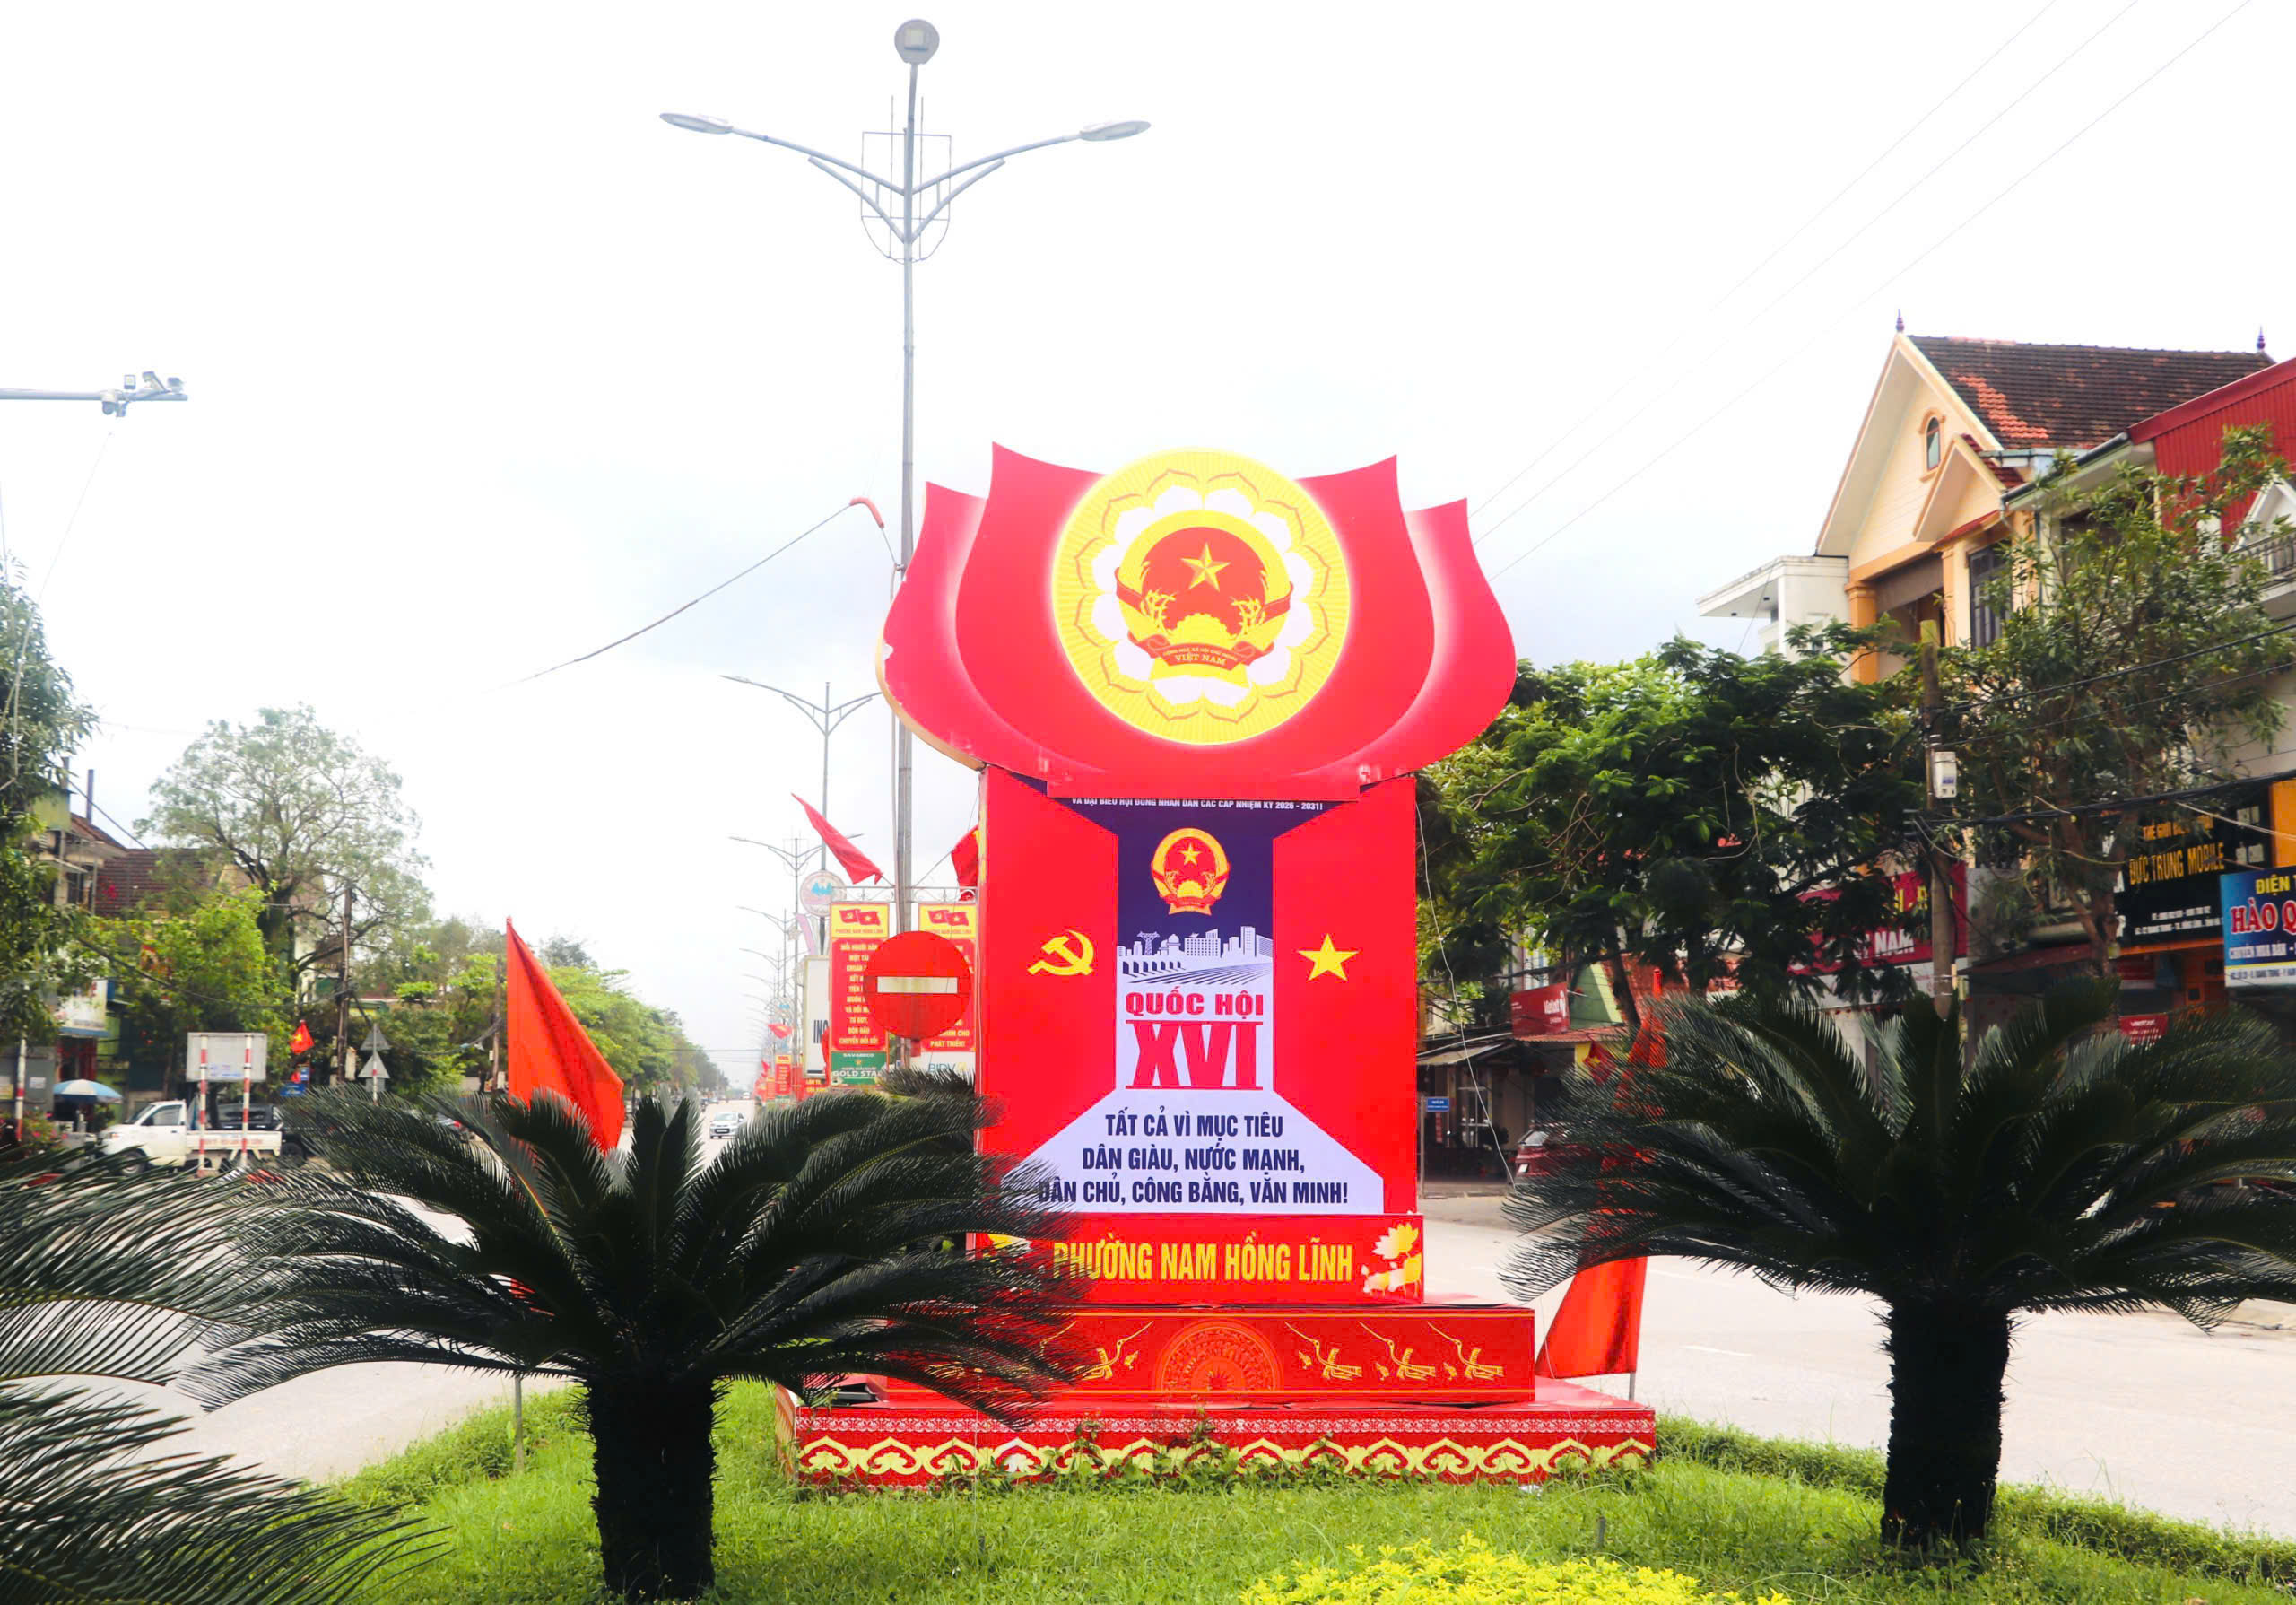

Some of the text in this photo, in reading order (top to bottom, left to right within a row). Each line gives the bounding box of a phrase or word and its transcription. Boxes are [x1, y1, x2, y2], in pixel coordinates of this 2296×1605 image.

[1176, 653, 1199, 661] VIỆT
[1202, 655, 1226, 665] NAM
[1275, 801, 1294, 809] 2026
[1301, 802, 1323, 810] 2031!
[2129, 853, 2150, 885] ĐỨC
[2151, 850, 2184, 882] TRUNG
[2187, 842, 2225, 875] MOBILE
[2256, 874, 2291, 895] ĐIỆN
[2231, 897, 2278, 934] HÀO
[1875, 929, 1915, 956] NAM
[1126, 986, 1264, 1019] QUỐC HỘI
[928, 1063, 956, 1073] BIDV
[1126, 1020, 1264, 1090] XVI
[1105, 1105, 1283, 1141] TẤT CẢ VÌ MỤC TIÊU
[1083, 1142, 1305, 1175] DÂN GIÀU, NƯỚC MẠNH,
[1083, 1172, 1126, 1205] CHỦ,
[1132, 1176, 1183, 1203] CÔNG
[1188, 1172, 1244, 1206] BẰNG,
[1250, 1176, 1287, 1203] VĂN
[1293, 1182, 1348, 1204] MINH!
[1053, 1230, 1353, 1282] PHƯỜNG NAM HỒNG LĨNH
